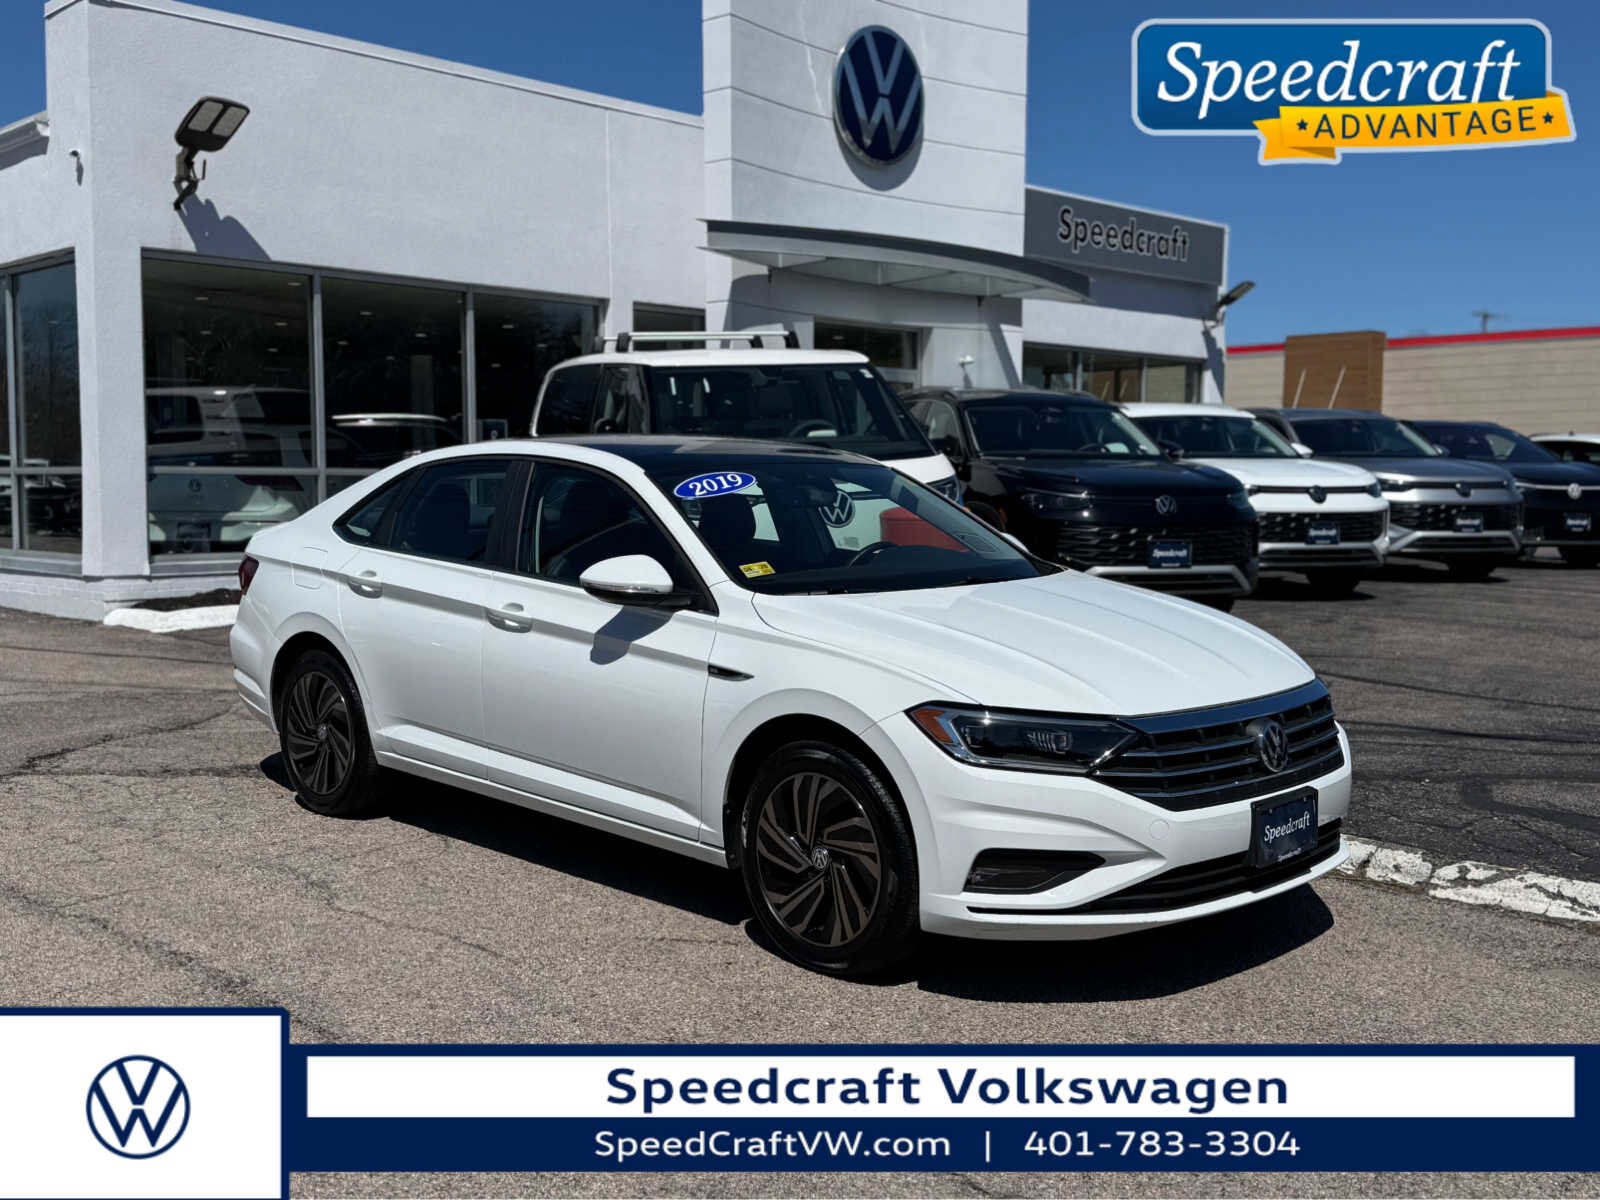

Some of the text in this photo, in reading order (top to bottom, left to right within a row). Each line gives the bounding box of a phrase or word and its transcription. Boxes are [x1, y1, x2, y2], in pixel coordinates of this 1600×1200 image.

[1057, 205, 1189, 261] Speedcraft
[688, 473, 743, 497] 2019
[1263, 811, 1310, 844] Speedcraft
